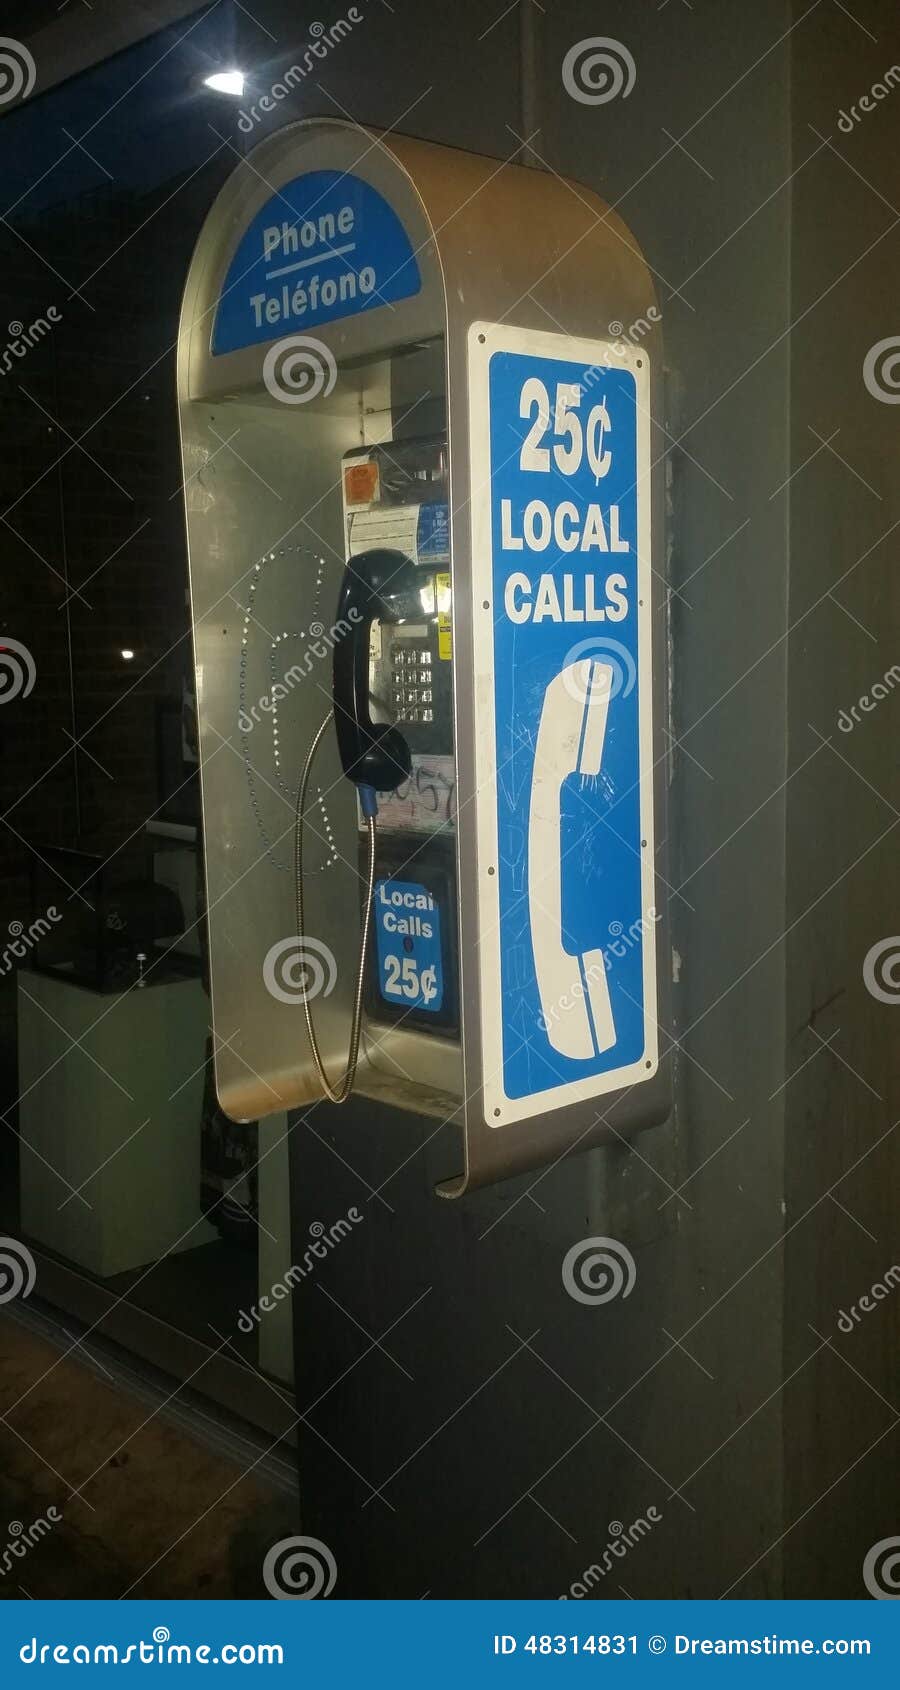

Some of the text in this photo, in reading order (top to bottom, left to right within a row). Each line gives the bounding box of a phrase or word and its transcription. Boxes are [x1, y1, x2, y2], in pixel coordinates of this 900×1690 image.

[263, 205, 355, 262] Phone
[249, 266, 376, 328] Teléfono
[518, 376, 613, 488] 25¢
[501, 498, 630, 553] LOCAL
[504, 571, 629, 625] CALLS
[382, 911, 433, 939] Calls
[383, 955, 438, 1005] 25¢
